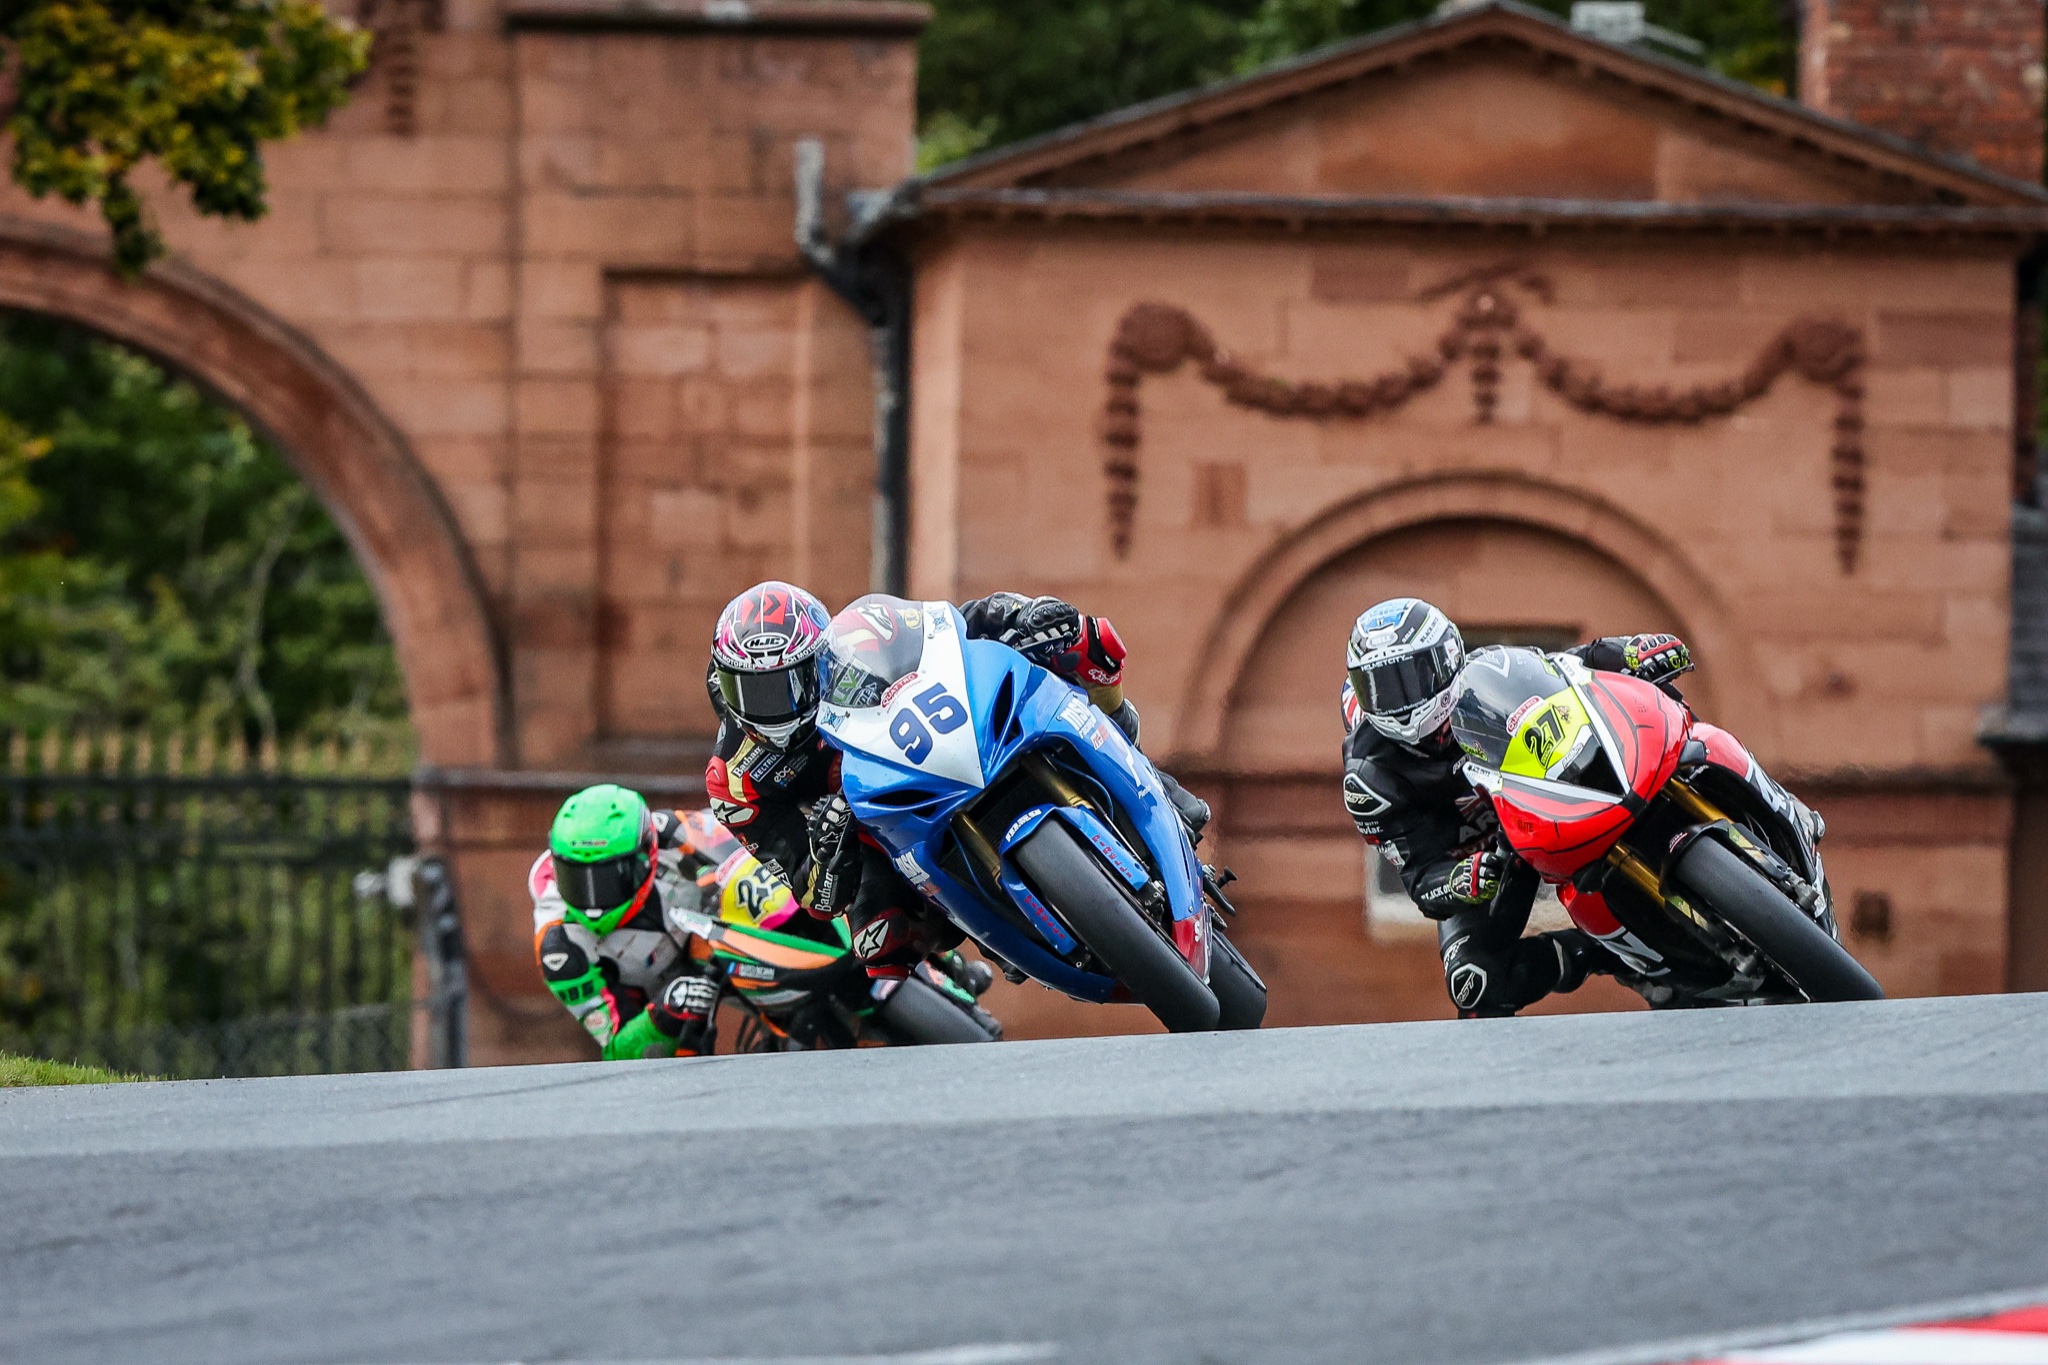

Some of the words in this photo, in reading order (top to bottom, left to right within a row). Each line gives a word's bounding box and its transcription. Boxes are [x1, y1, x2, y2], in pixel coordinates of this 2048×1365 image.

[749, 637, 781, 648] HJC
[881, 671, 919, 708] QUATTRO
[889, 682, 968, 766] 95
[1508, 697, 1540, 732] QUATTRO
[1523, 705, 1565, 769] 27
[773, 765, 791, 783] ebc
[1344, 789, 1374, 805] RST
[1456, 971, 1476, 1005] RST
